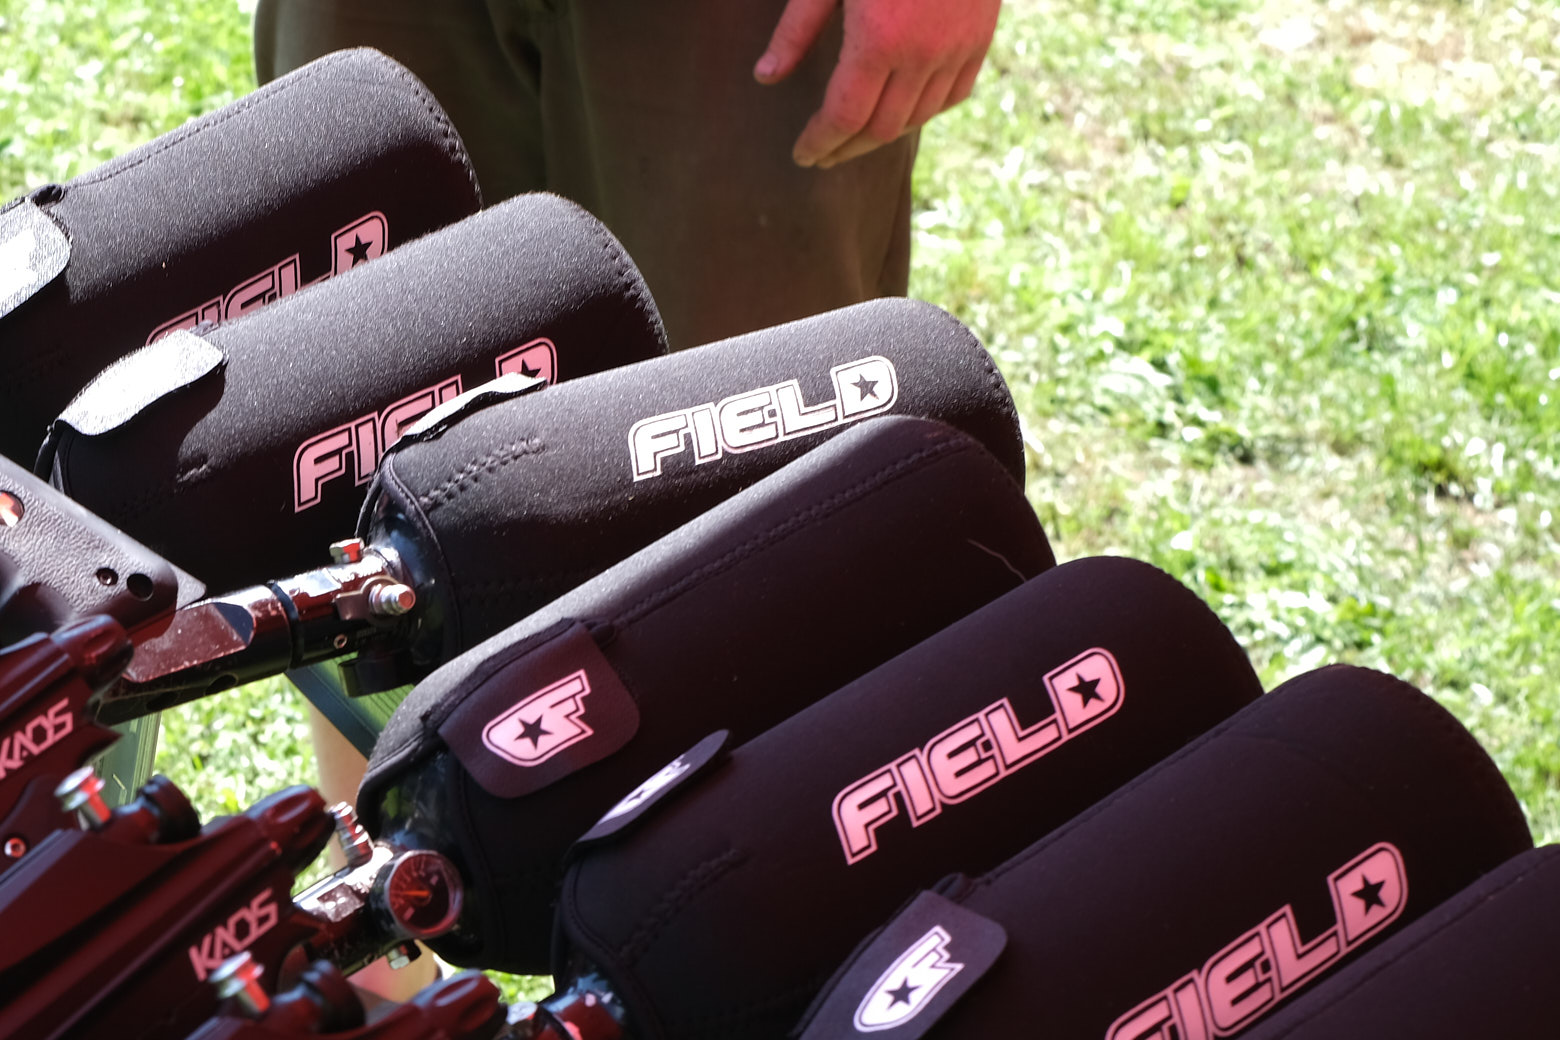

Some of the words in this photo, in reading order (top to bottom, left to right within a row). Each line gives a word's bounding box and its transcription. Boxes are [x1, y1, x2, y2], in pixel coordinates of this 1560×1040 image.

[627, 354, 898, 483] FIELD
[831, 646, 1125, 866] FIELD
[188, 887, 279, 982] KAOS
